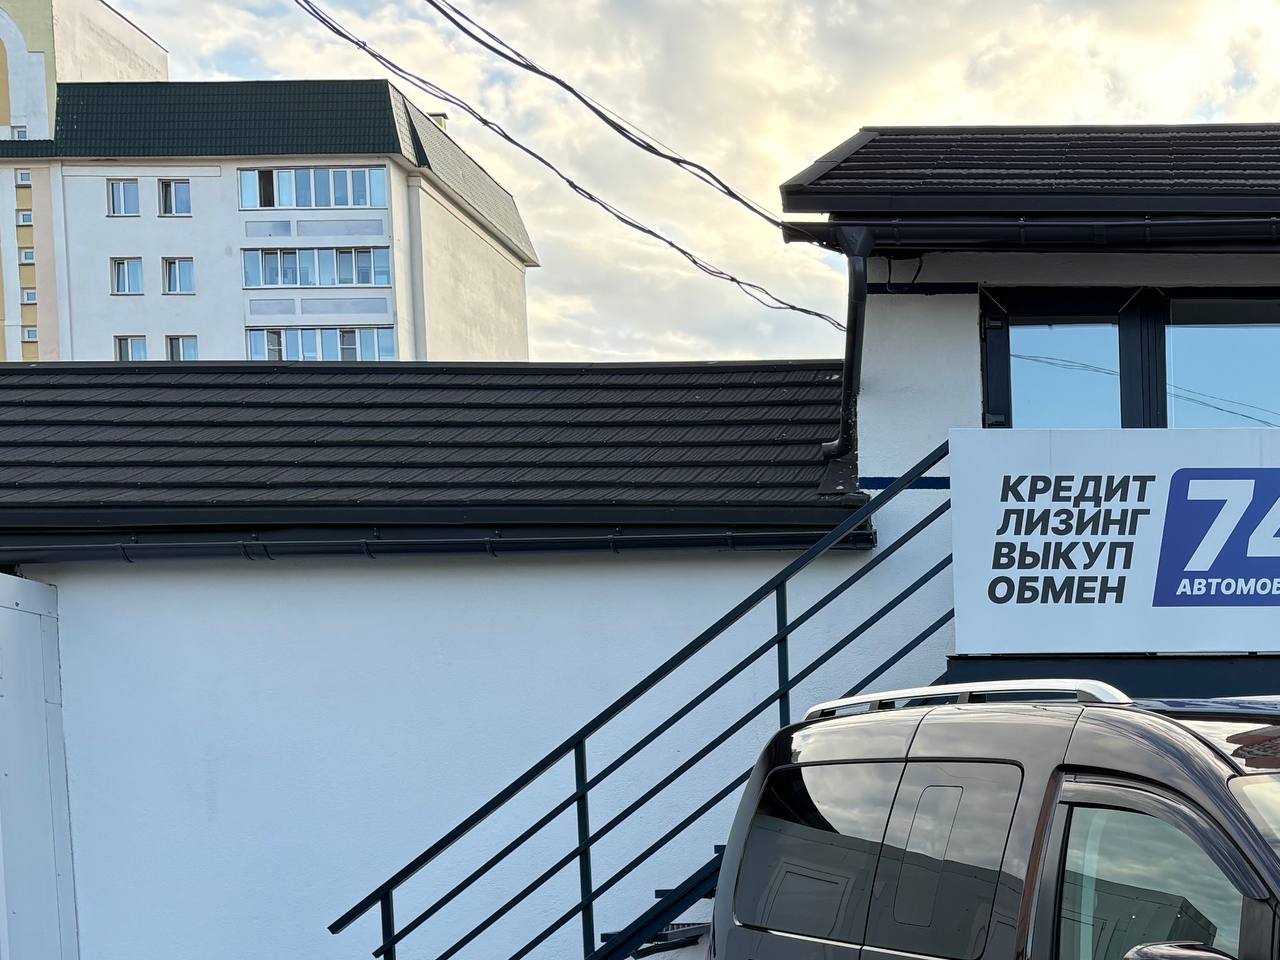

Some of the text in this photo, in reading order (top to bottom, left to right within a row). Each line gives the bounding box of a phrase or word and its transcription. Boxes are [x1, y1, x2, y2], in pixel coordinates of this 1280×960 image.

[1000, 475, 1156, 508] КРЕДИТ
[996, 508, 1151, 536] ЛИЗИНГ
[992, 541, 1134, 570] ВЫКУП
[987, 576, 1126, 604] ОБМЕН
